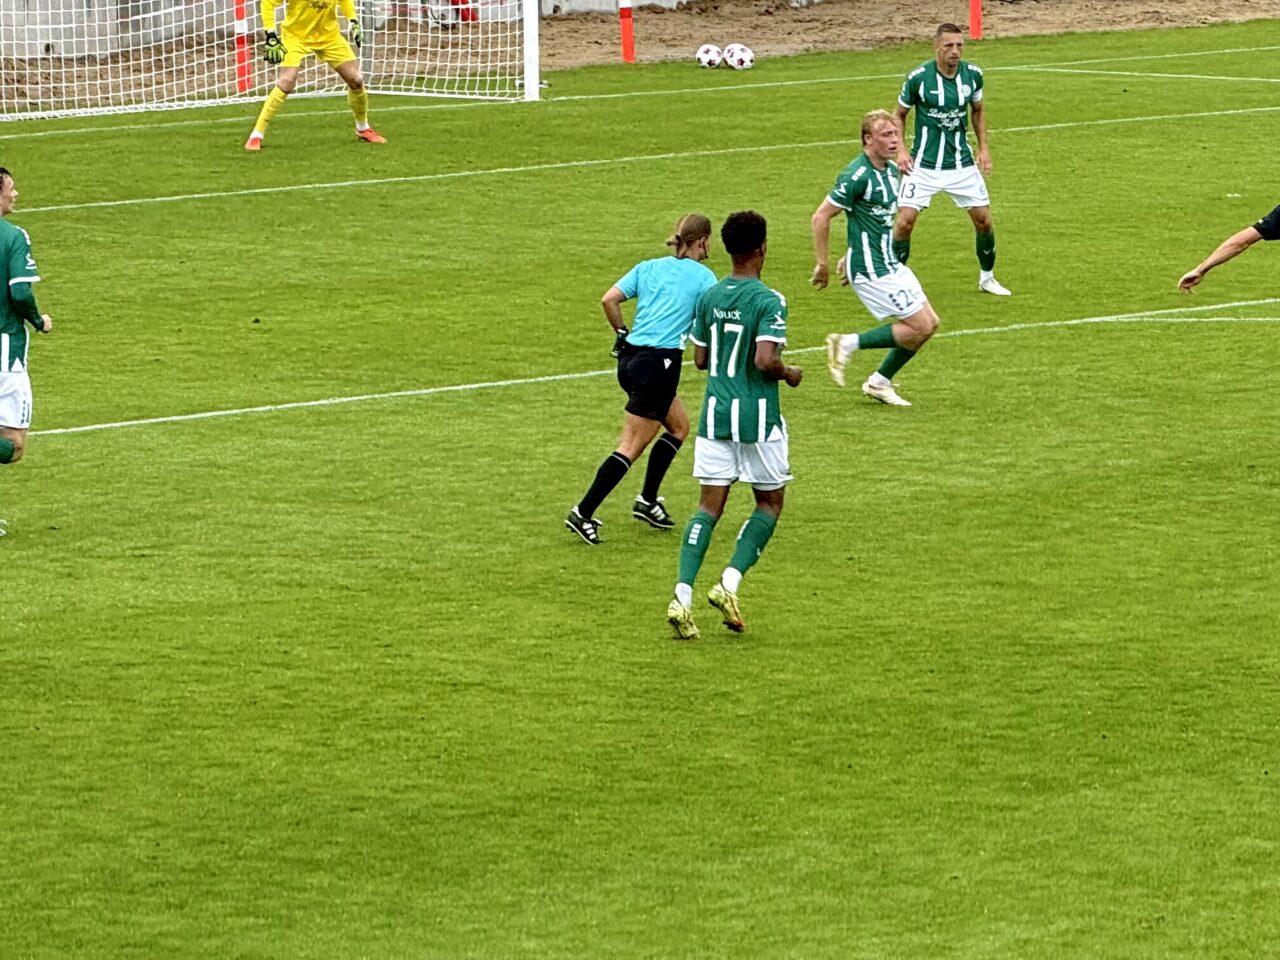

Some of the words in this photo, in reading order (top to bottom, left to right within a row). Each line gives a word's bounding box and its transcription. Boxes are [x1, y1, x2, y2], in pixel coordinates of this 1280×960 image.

[900, 182, 916, 199] 13
[712, 307, 742, 321] Nauck
[709, 322, 744, 378] 17
